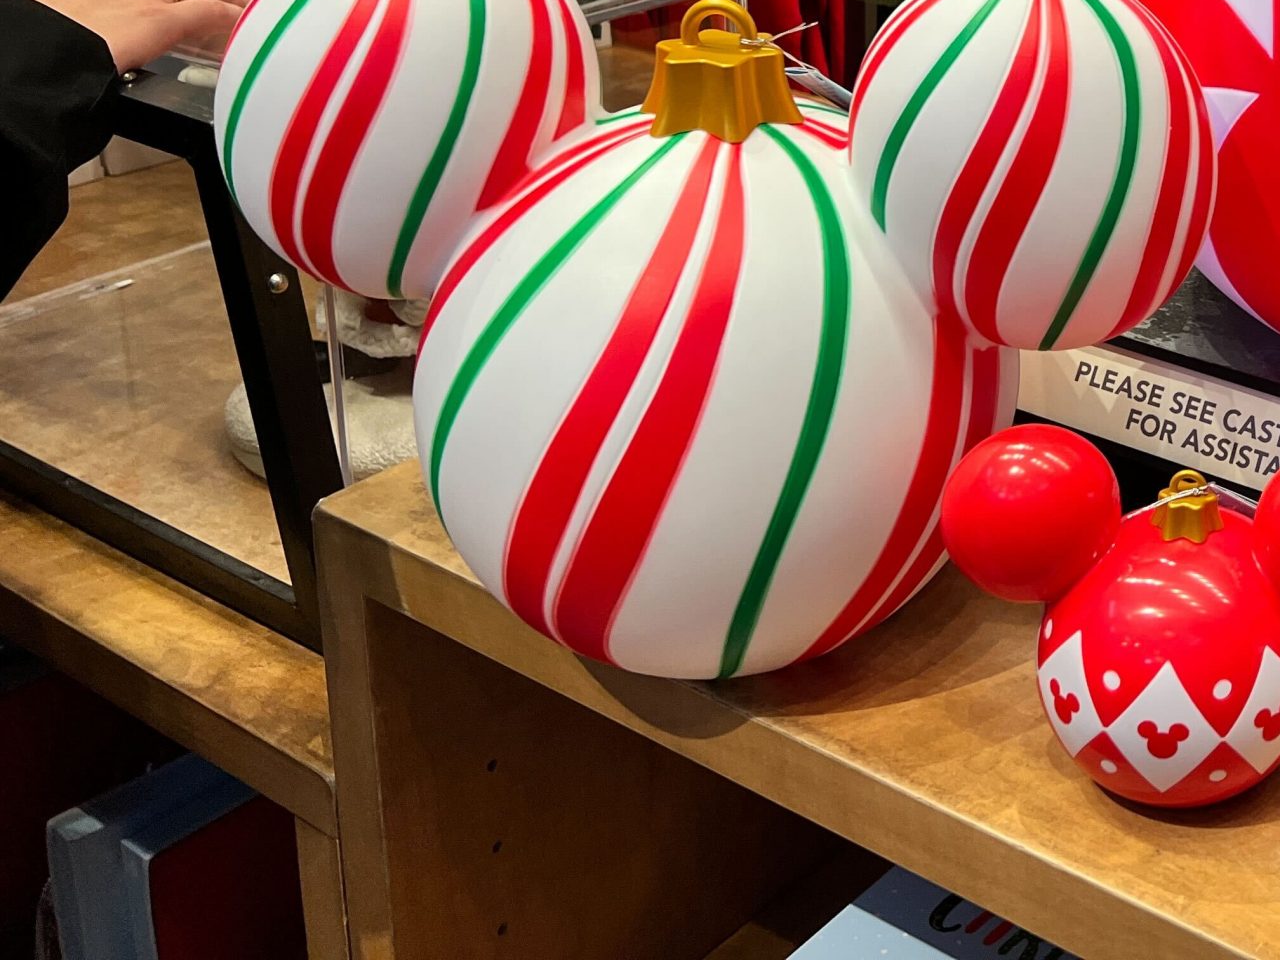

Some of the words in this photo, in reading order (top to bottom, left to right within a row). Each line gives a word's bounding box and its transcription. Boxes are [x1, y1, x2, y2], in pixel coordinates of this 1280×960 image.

[1075, 361, 1165, 408] PLEASE
[1169, 391, 1217, 425] SEE
[1126, 408, 1177, 444] FOR
